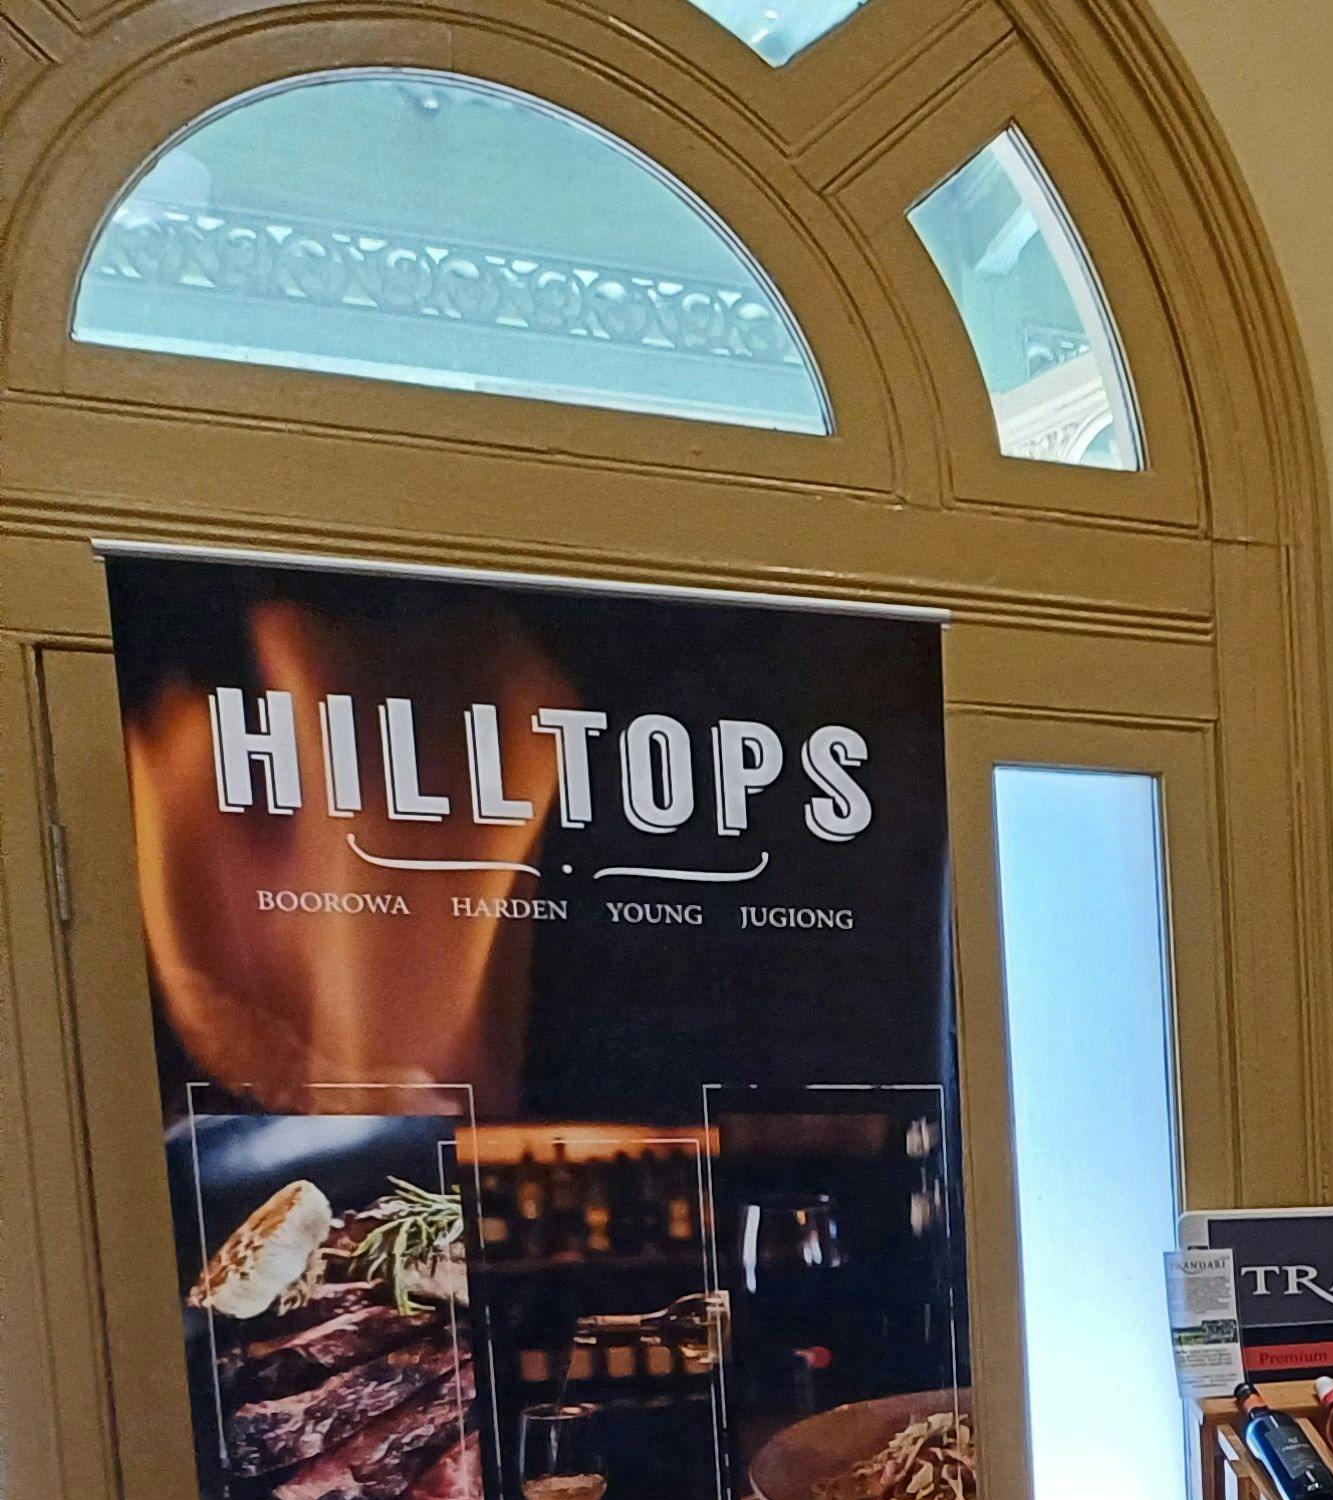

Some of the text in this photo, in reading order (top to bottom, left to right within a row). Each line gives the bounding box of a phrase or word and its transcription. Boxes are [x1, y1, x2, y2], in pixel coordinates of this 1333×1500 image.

[209, 687, 873, 842] HILLTOPS
[257, 890, 854, 930] BOOROWA HARDEN YOUNG JUGIONG
[1259, 1350, 1328, 1365] Premium
